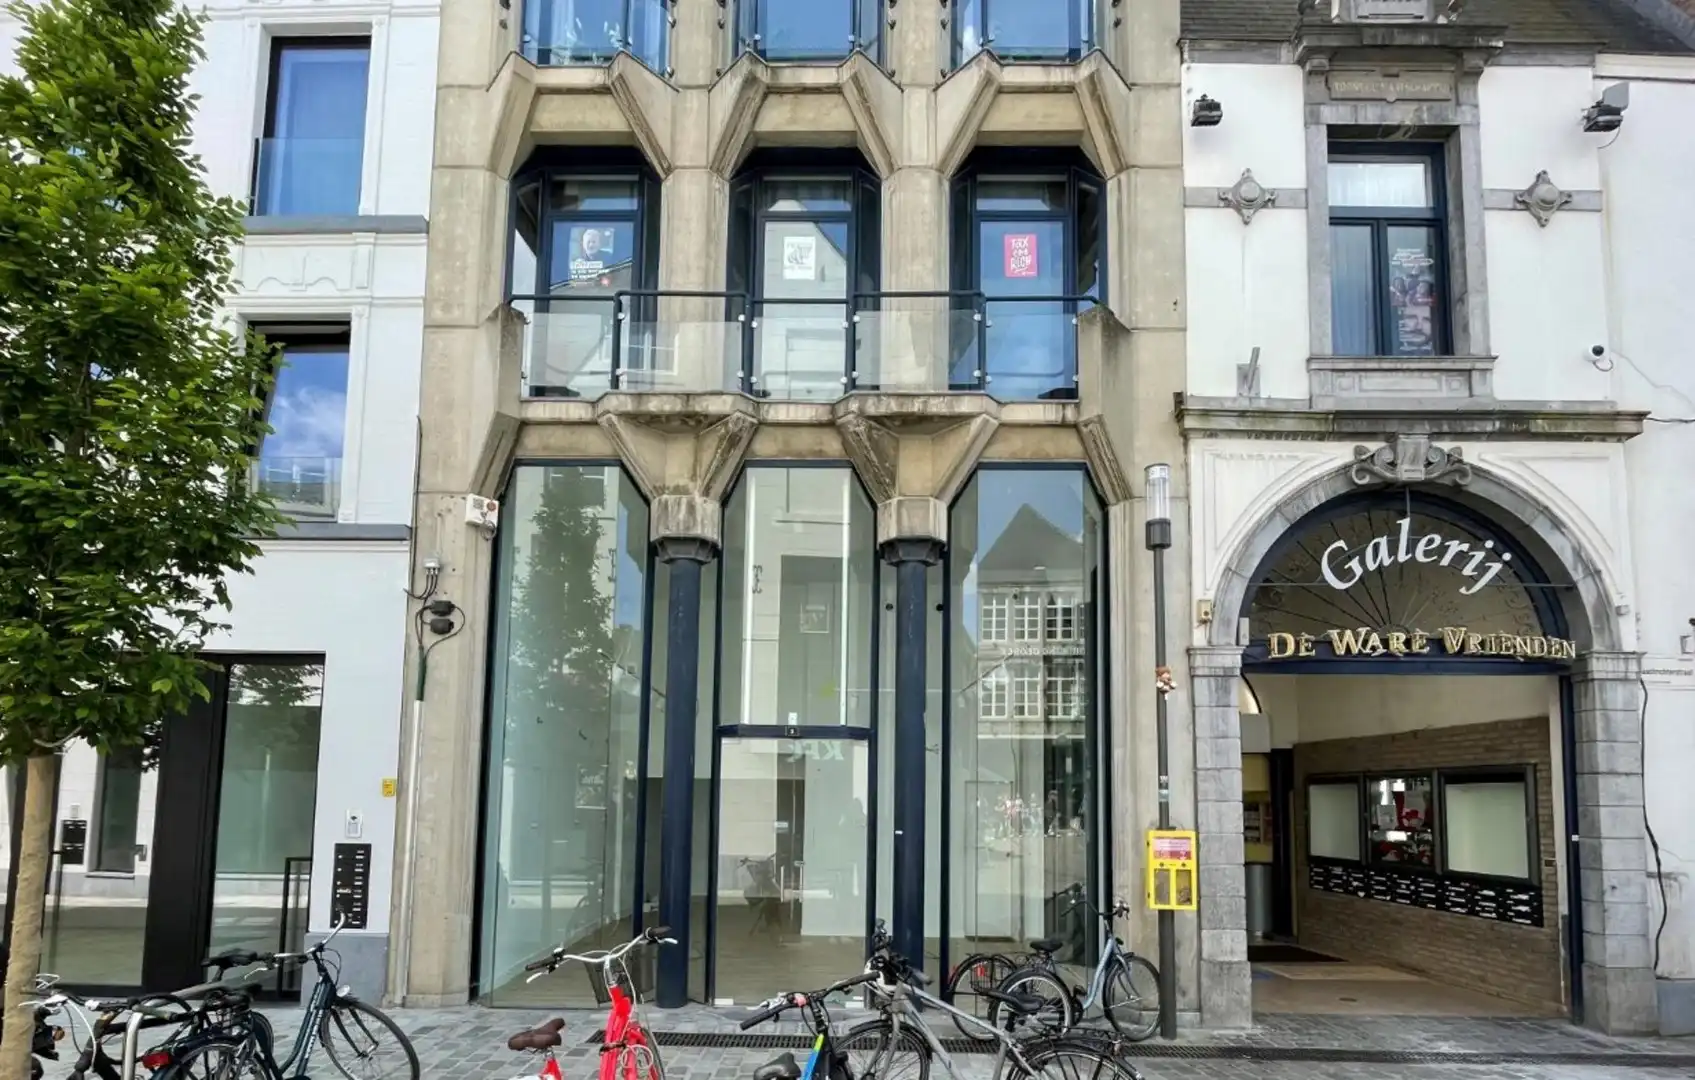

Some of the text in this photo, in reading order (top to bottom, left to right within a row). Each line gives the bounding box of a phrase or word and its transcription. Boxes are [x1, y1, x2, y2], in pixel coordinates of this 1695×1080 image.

[1320, 516, 1512, 595] Galerij
[1267, 627, 1577, 661] DE WARE VRIENDEN
